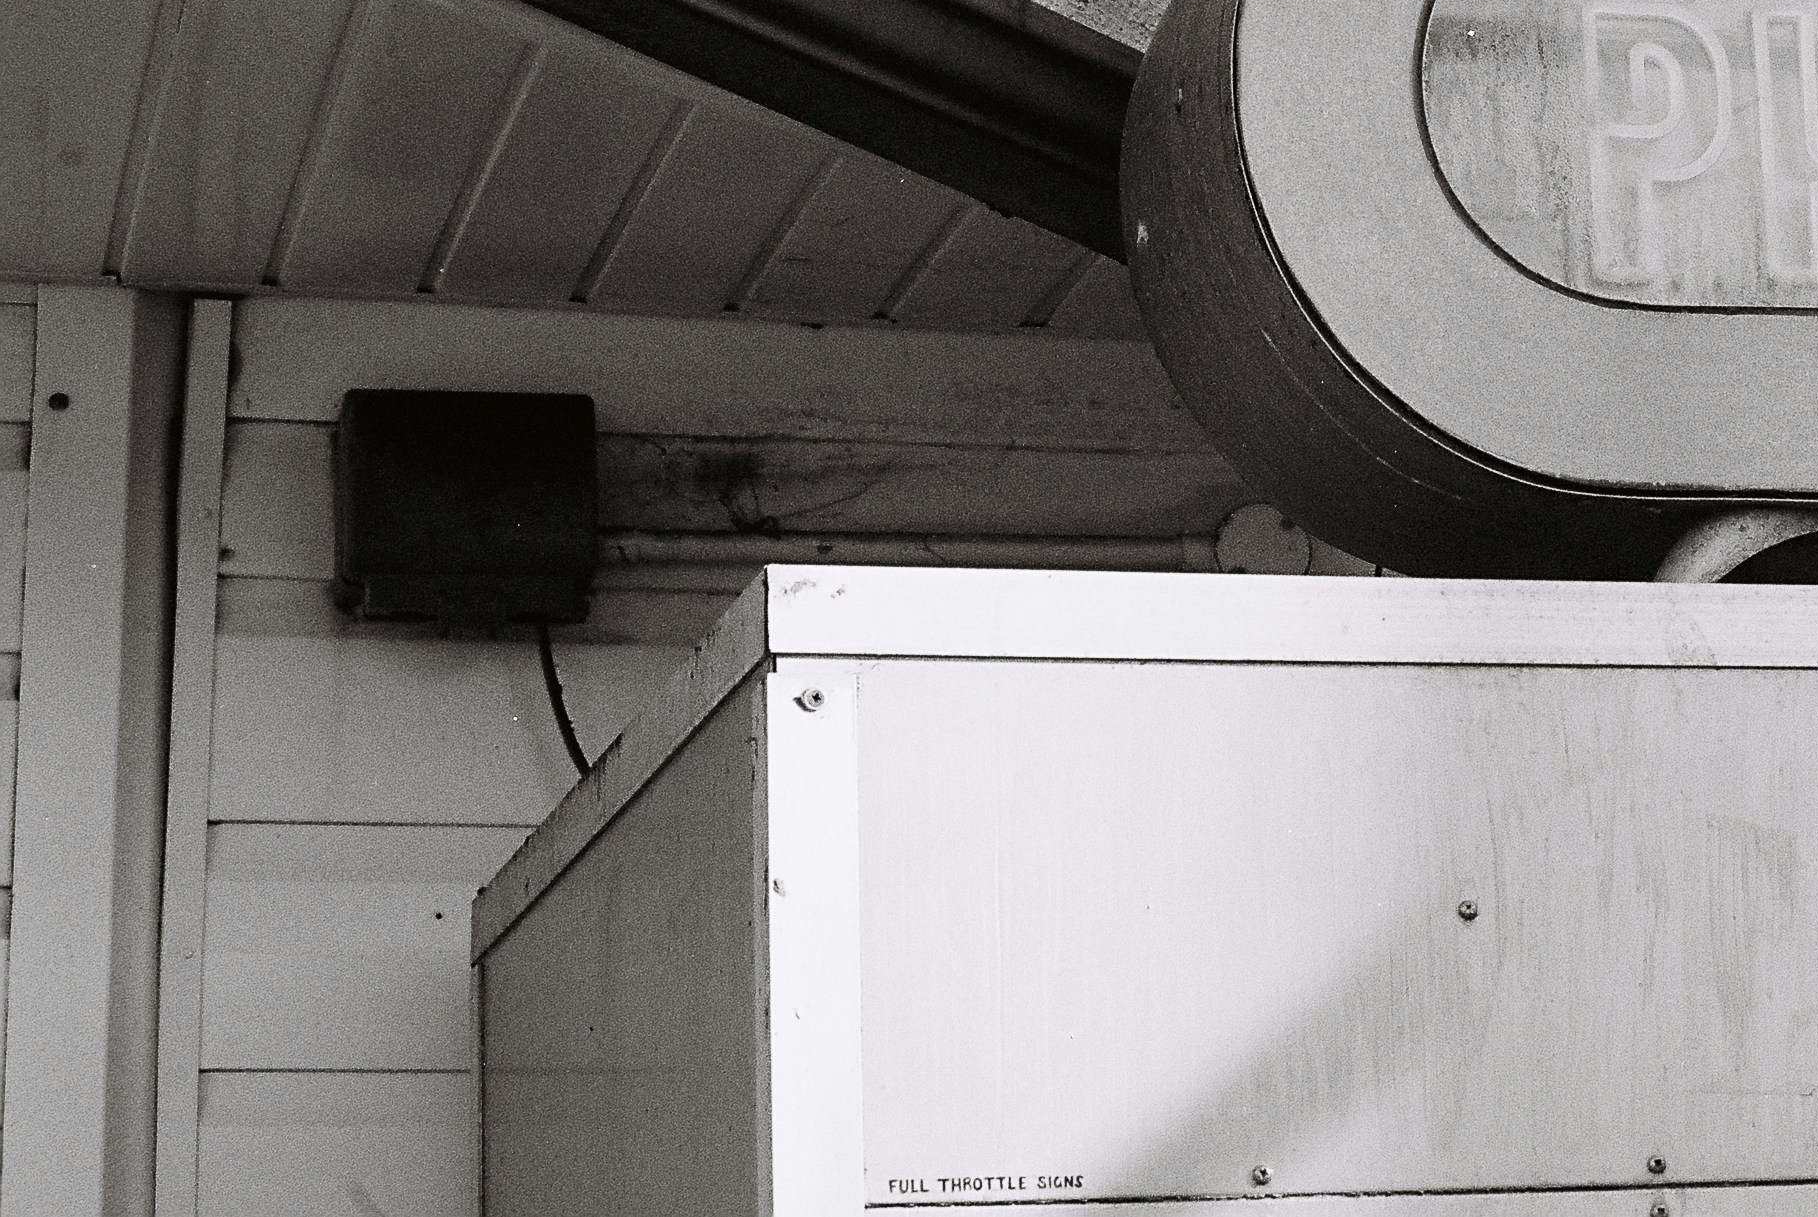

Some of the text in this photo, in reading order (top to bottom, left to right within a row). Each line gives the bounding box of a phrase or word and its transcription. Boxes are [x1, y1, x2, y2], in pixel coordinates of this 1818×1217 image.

[888, 1174, 1085, 1194] FULL THROTTLE SIGNS
